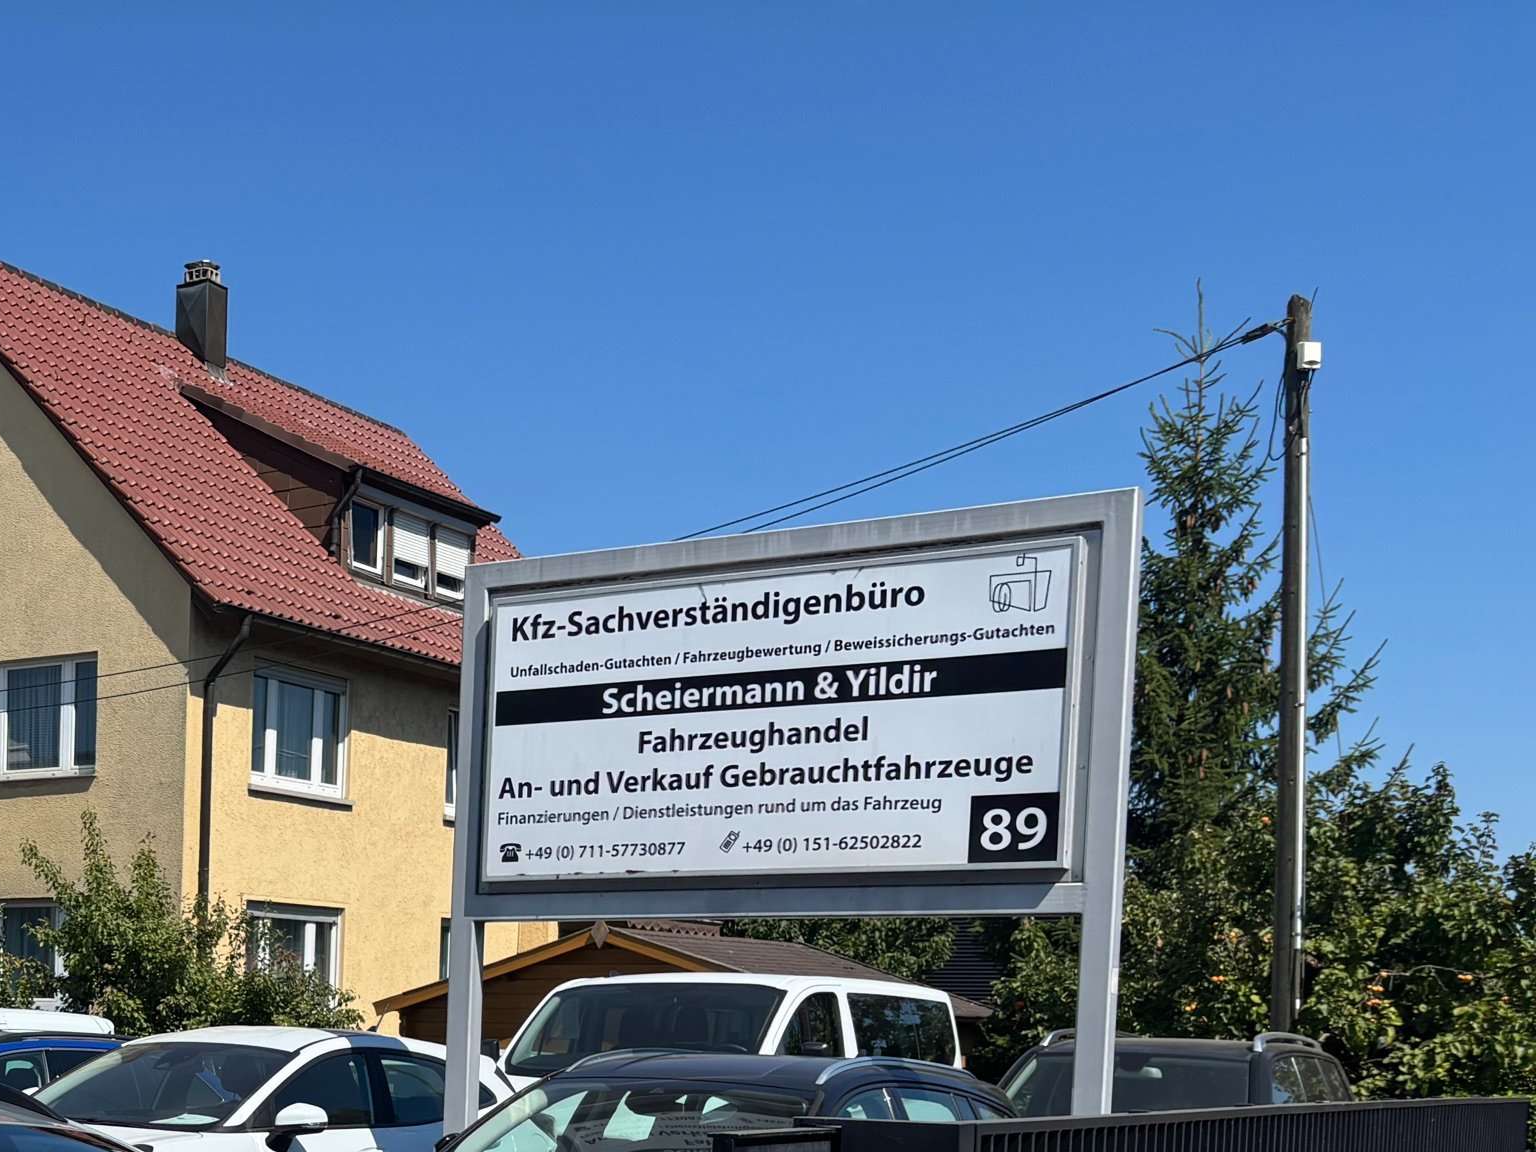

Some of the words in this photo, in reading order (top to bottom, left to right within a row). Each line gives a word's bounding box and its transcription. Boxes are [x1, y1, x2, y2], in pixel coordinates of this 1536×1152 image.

[512, 581, 925, 642] Kfz-Sachverständigenbüro
[511, 655, 672, 678] Unfallschaden-Gutachten
[683, 644, 822, 664] Fahrzeugbewertung
[834, 624, 1055, 652] Beweissicherungs-Gutachten
[601, 679, 805, 715] Scheiermann
[814, 672, 839, 699] &
[846, 664, 937, 697] Yildir
[638, 716, 868, 754] Fahrzeughandel
[498, 777, 542, 799] An-
[550, 771, 600, 797] und
[606, 764, 714, 794] Verkauf
[720, 754, 1033, 788] Gebrauchtfahrzeuge
[498, 810, 609, 825] Finanzierungen
[623, 803, 753, 820] Dienstleistungen
[758, 798, 796, 814] rund
[801, 801, 826, 812] um
[831, 796, 859, 812] das
[864, 795, 942, 813] Fahrzeug
[980, 807, 1047, 851] 89
[525, 846, 552, 860] +49
[556, 845, 574, 861] (0)
[579, 841, 686, 858] 711-57730877
[742, 839, 773, 853] +49
[777, 837, 797, 854] (0)
[803, 834, 922, 851] 151-62502822
